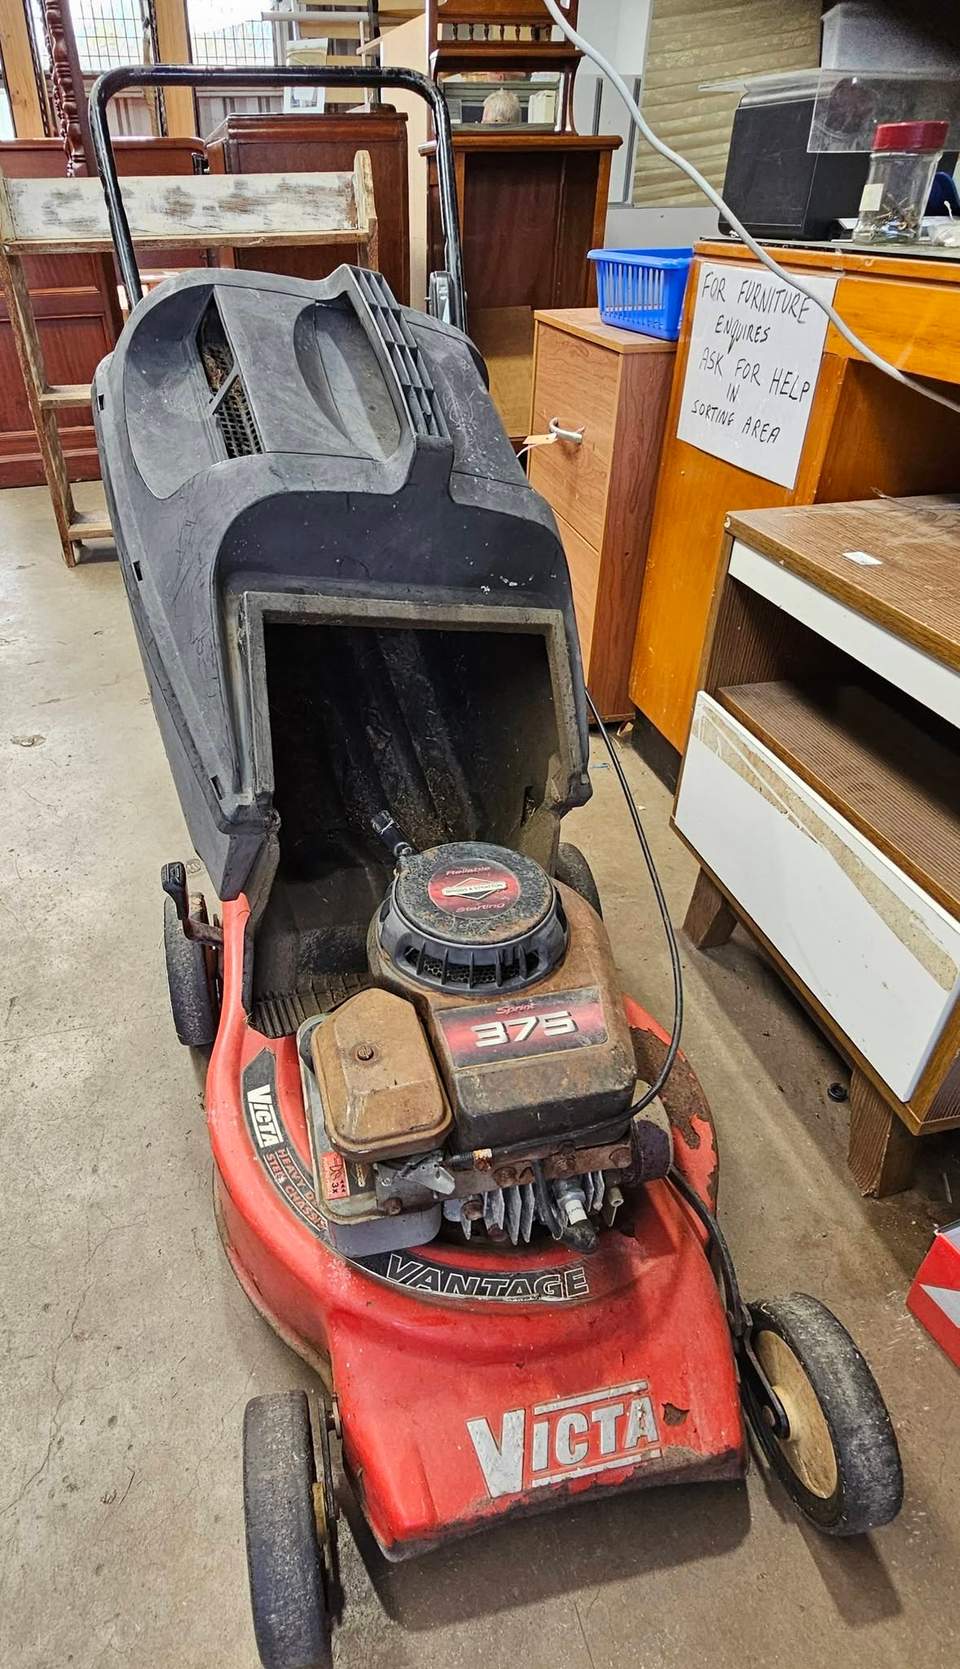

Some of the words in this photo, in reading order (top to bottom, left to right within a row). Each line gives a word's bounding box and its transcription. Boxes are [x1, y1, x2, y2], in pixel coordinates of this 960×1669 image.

[702, 271, 726, 302] FOR
[737, 279, 810, 324] FURNITURE
[699, 347, 724, 376] ASK
[735, 358, 760, 386] FOR
[769, 367, 811, 402] HELP
[726, 383, 740, 402] IN
[691, 400, 735, 426] SORTING
[742, 416, 781, 443] AREA
[471, 1010, 577, 1048] 375
[495, 1001, 536, 1015] Sprint
[247, 1084, 284, 1148] VICTA
[278, 1149, 306, 1188] HEAVY
[284, 1185, 328, 1229] CHASSIS
[386, 1253, 590, 1299] VANTAGE
[466, 1381, 662, 1499] VICTA
